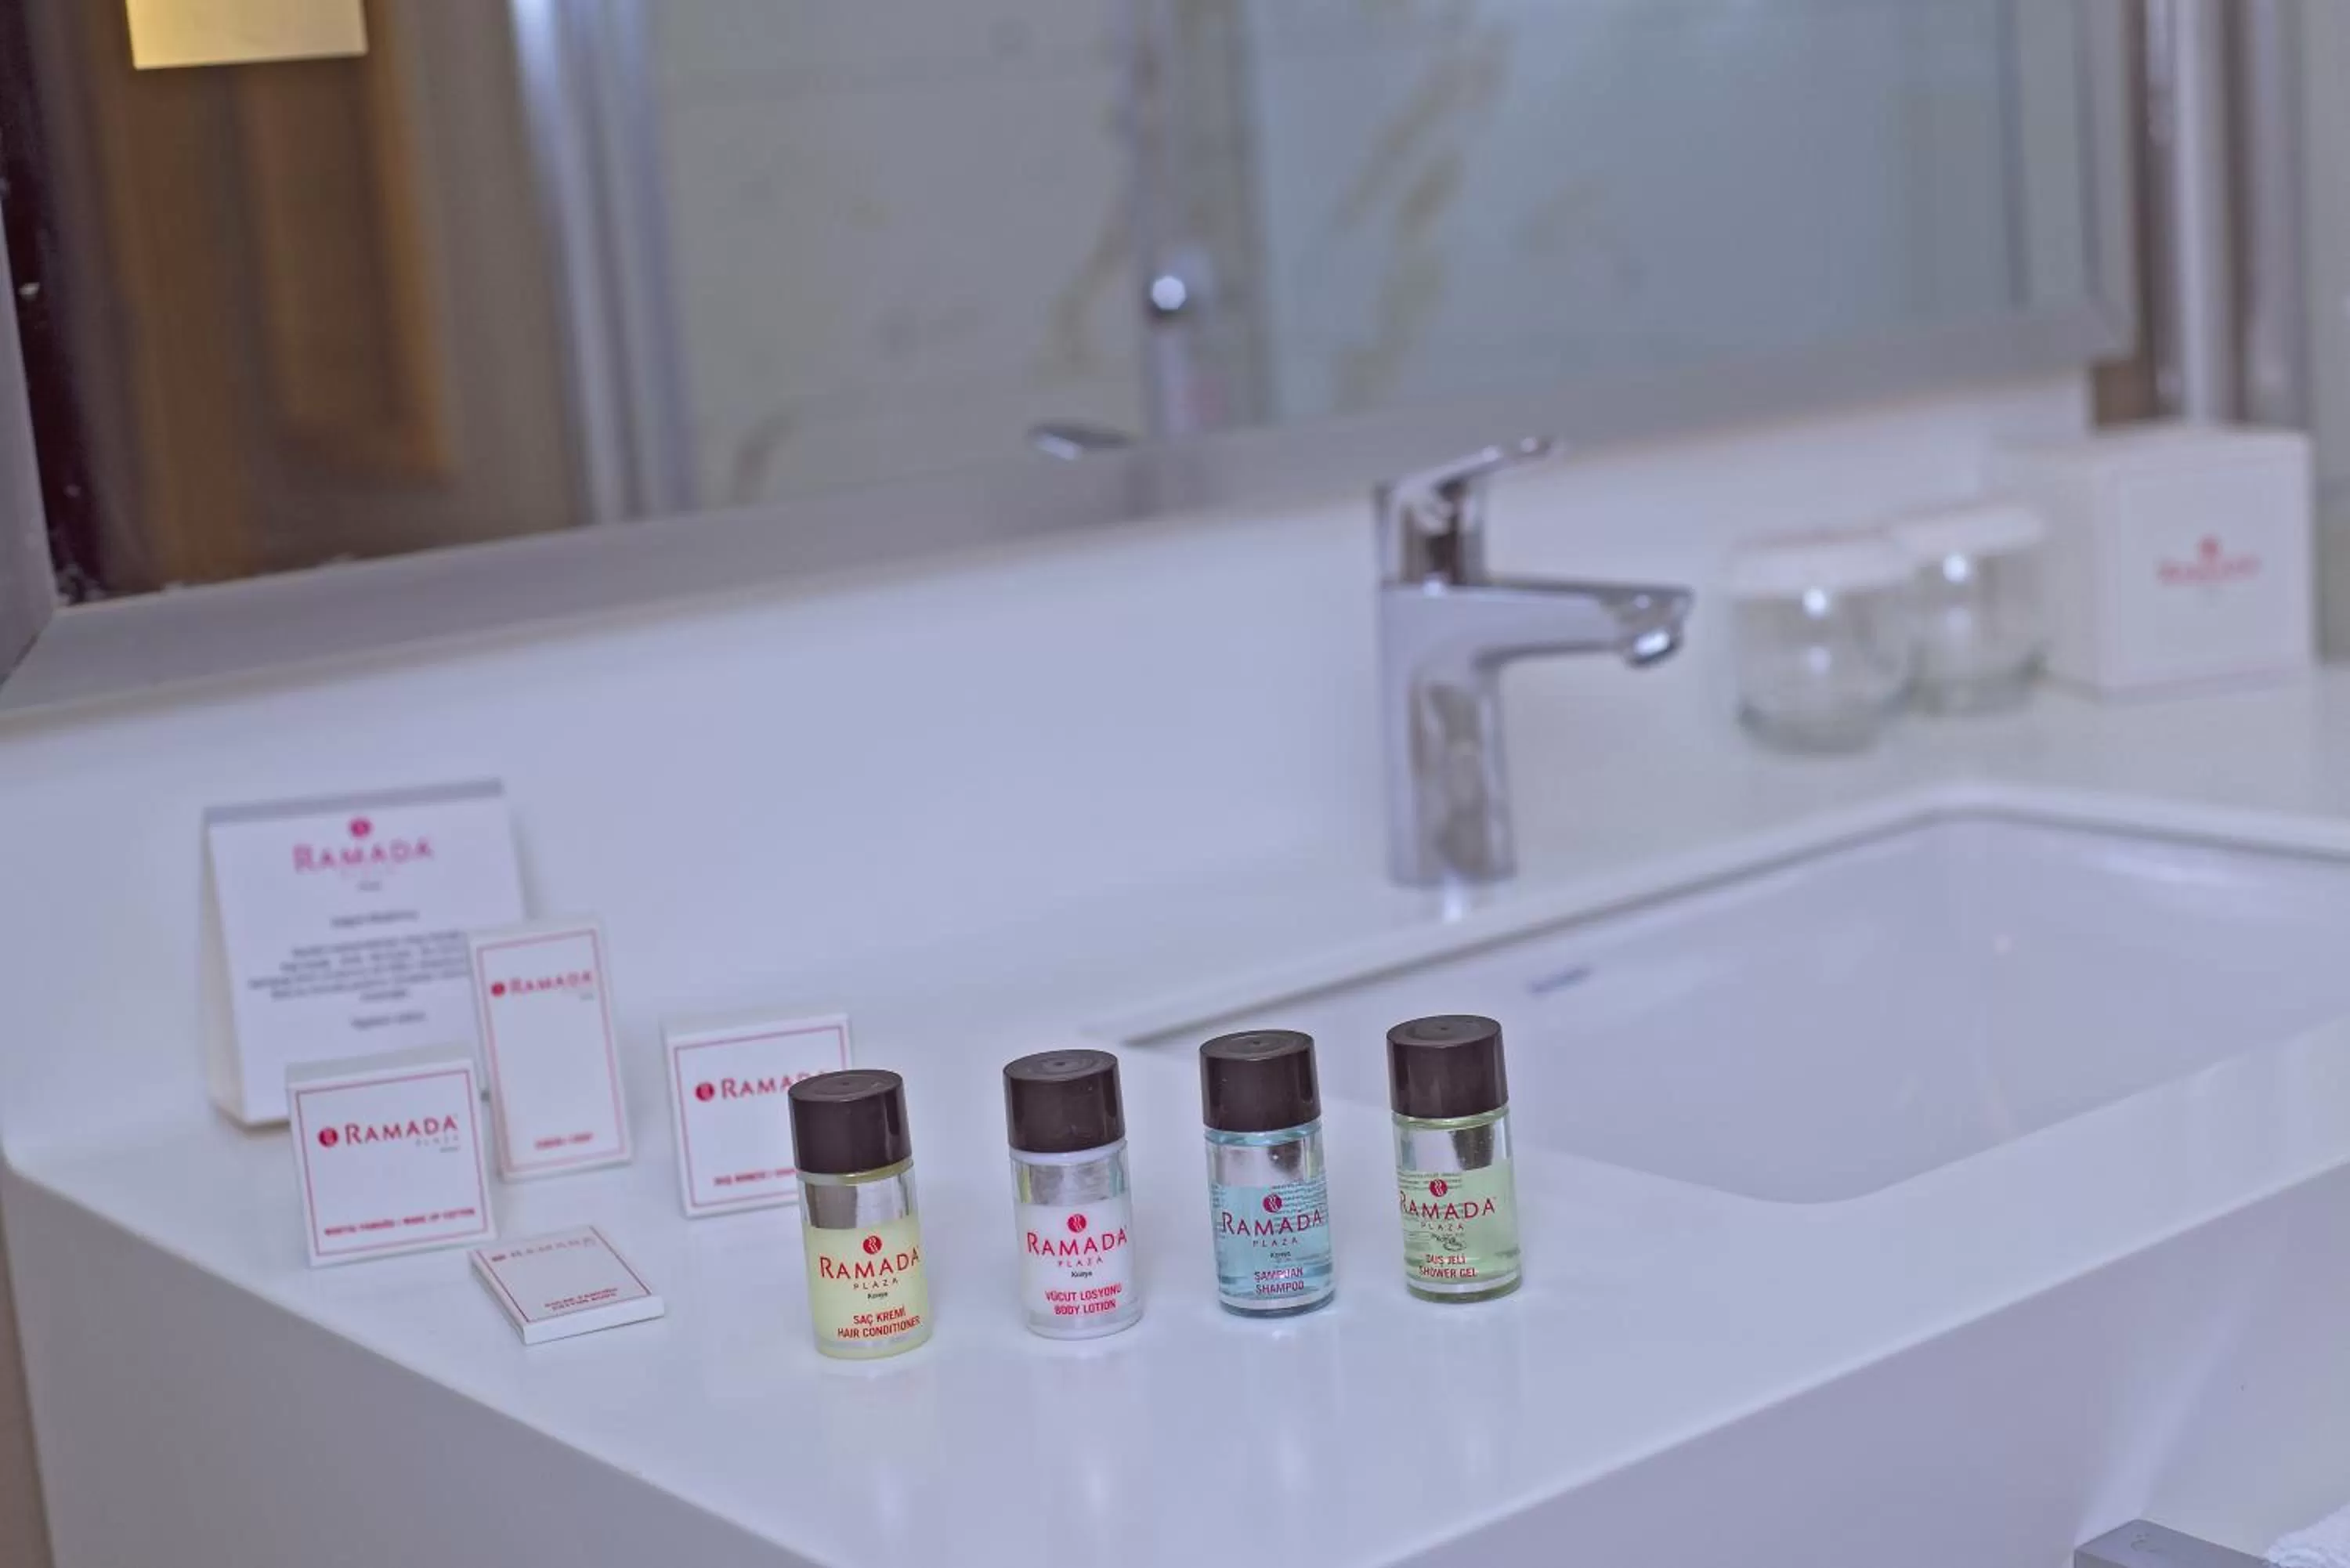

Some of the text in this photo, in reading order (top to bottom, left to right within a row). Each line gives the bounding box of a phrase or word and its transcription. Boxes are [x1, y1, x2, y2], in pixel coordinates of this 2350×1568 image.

[292, 836, 434, 874] RAMADA
[721, 1071, 826, 1100] RAMA
[345, 1115, 457, 1146] RAMADA
[1399, 1190, 1495, 1219] RAMADA
[1222, 1209, 1321, 1236] RAMADA
[1421, 1222, 1463, 1232] PLAZA
[1027, 1227, 1127, 1256] RAMADA
[1253, 1237, 1298, 1248] PLAZA
[819, 1246, 920, 1280] RAMADA
[1058, 1256, 1103, 1267] PLAZA
[1419, 1265, 1477, 1278] SHOWER GEL
[853, 1277, 898, 1290] PLAZA
[1080, 1283, 1122, 1301] LOSYONU
[1255, 1281, 1304, 1295] SHAMPOO
[1054, 1299, 1116, 1315] BODY LOTION
[837, 1315, 921, 1339] HAIR CONDITIONER
[853, 1313, 873, 1326] SAÇ
